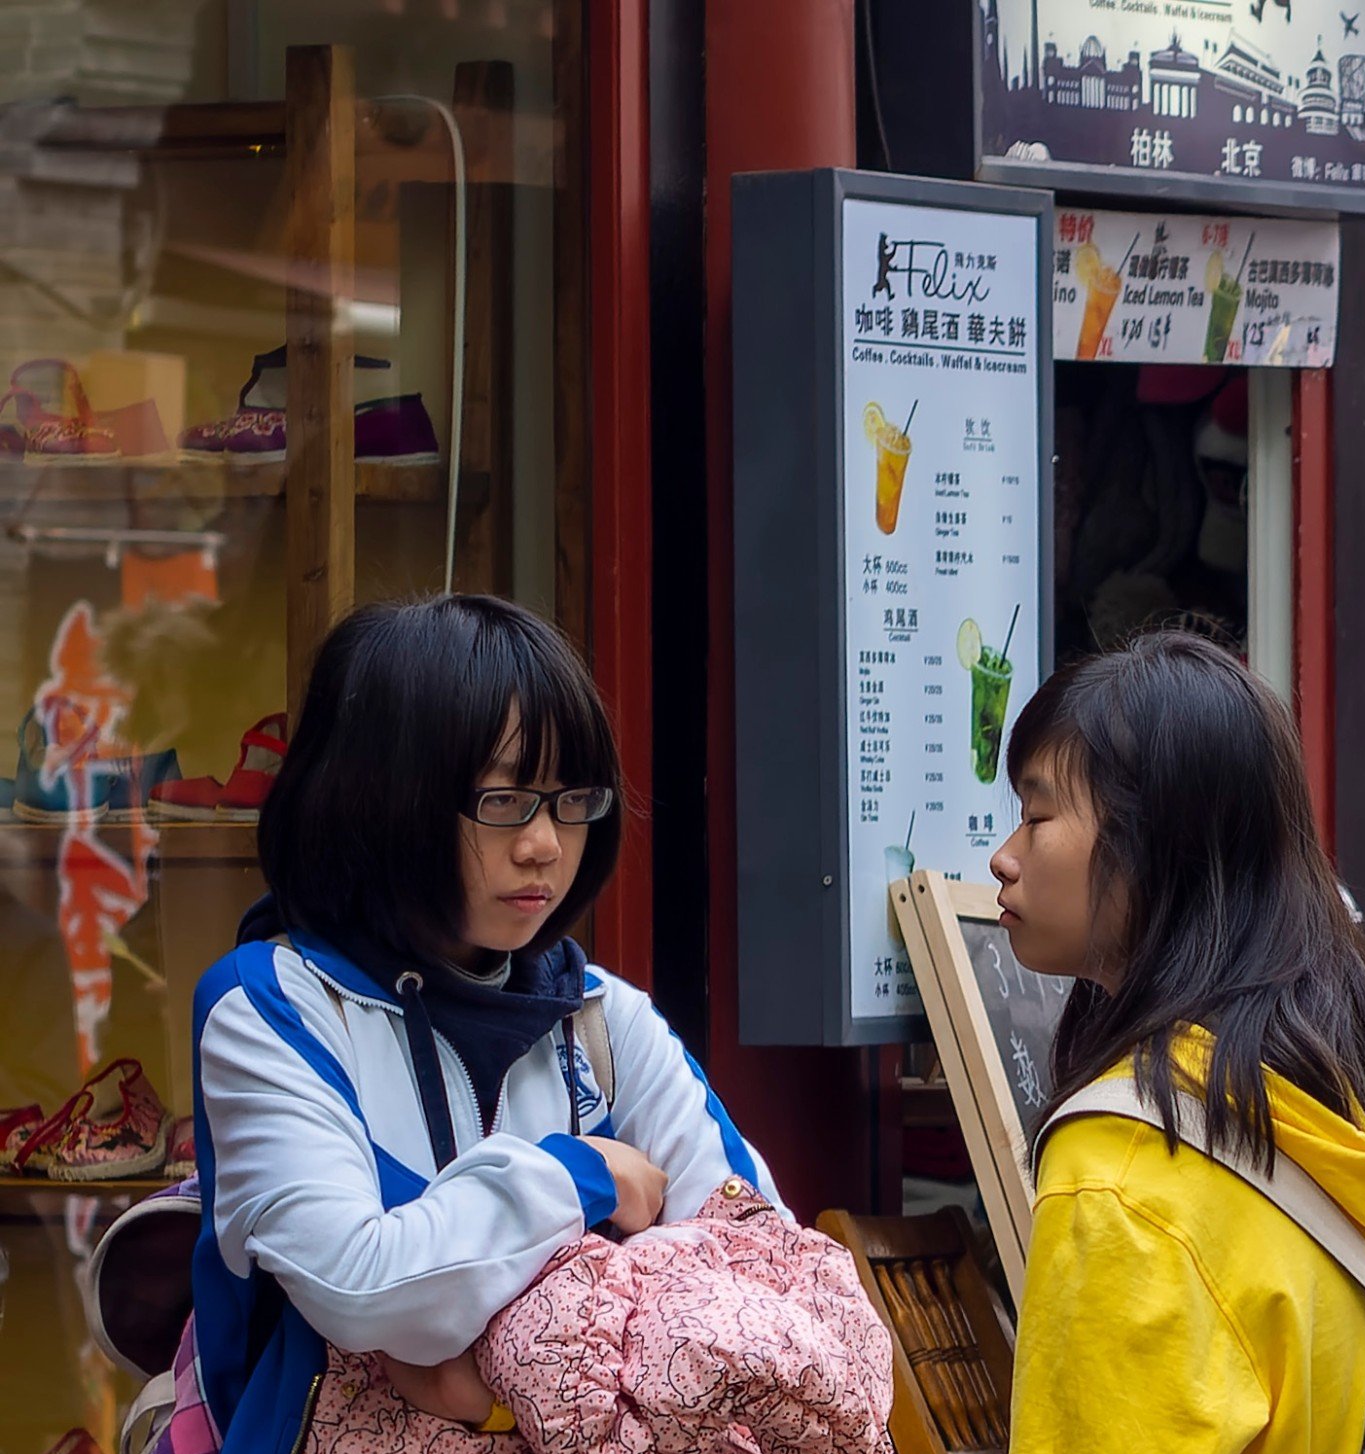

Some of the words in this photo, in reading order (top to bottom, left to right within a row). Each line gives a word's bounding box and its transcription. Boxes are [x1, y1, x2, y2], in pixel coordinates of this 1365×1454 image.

[1131, 127, 1174, 169] 柏林
[1221, 138, 1262, 178] 北京
[888, 240, 990, 305] Felix
[1123, 285, 1148, 305] Iced
[1148, 286, 1184, 307] Lemon
[1187, 287, 1204, 307] Tea
[1246, 289, 1279, 313] Mojito
[855, 303, 893, 336] 咖啡
